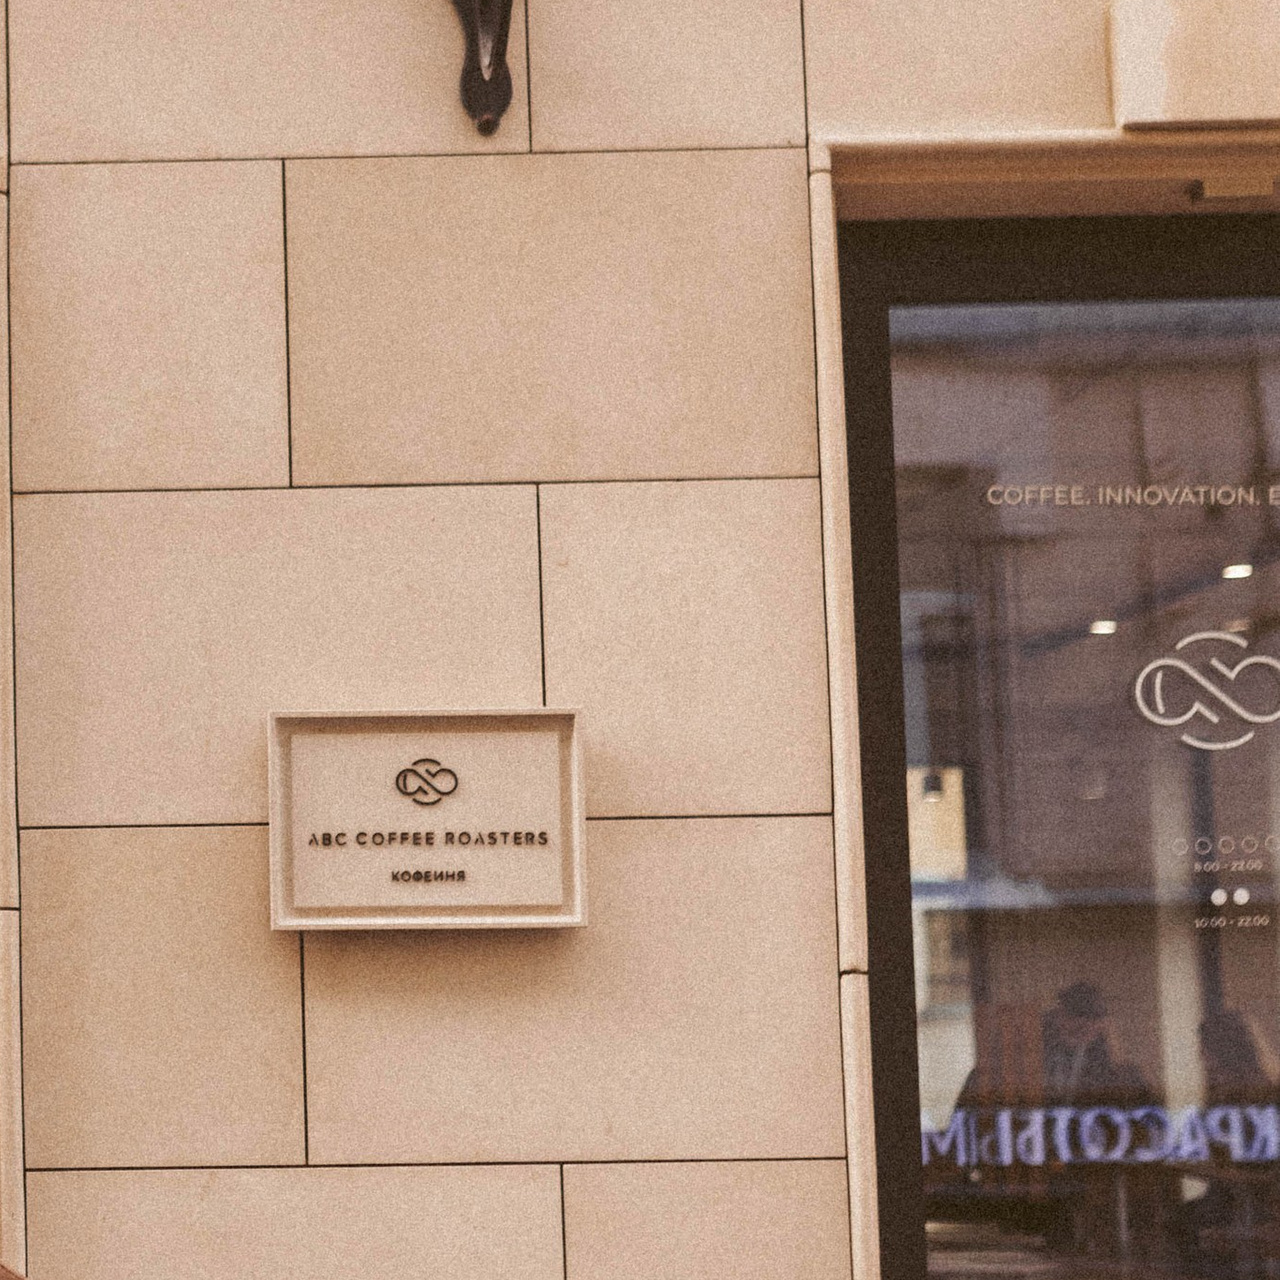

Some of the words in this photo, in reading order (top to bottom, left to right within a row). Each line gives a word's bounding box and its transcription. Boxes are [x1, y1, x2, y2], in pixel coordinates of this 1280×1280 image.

[986, 484, 1091, 506] COFFEE.
[1097, 483, 1260, 506] INNOVATION.
[308, 831, 347, 847] ABC
[355, 831, 435, 847] COFFEE
[445, 831, 548, 846] ROASTERS
